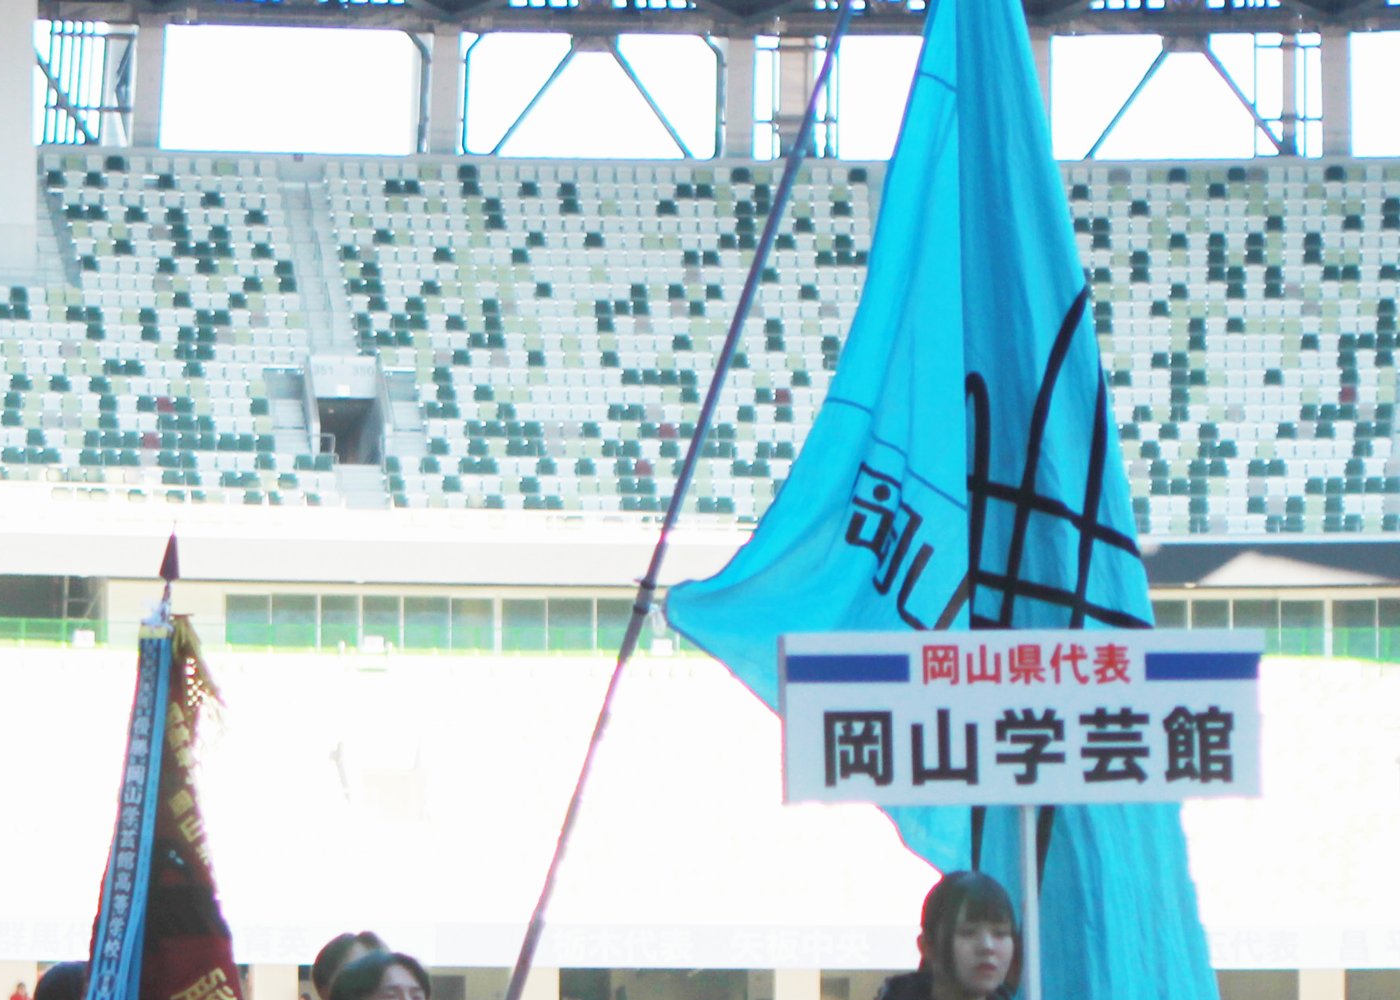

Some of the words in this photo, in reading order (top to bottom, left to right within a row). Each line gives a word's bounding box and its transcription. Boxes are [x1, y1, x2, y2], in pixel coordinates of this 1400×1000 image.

[921, 643, 1131, 685] 岡山県代表
[822, 706, 1236, 788] 岡山学芸館
[552, 927, 695, 964] 栃木代表
[729, 927, 871, 964] 矢板中央
